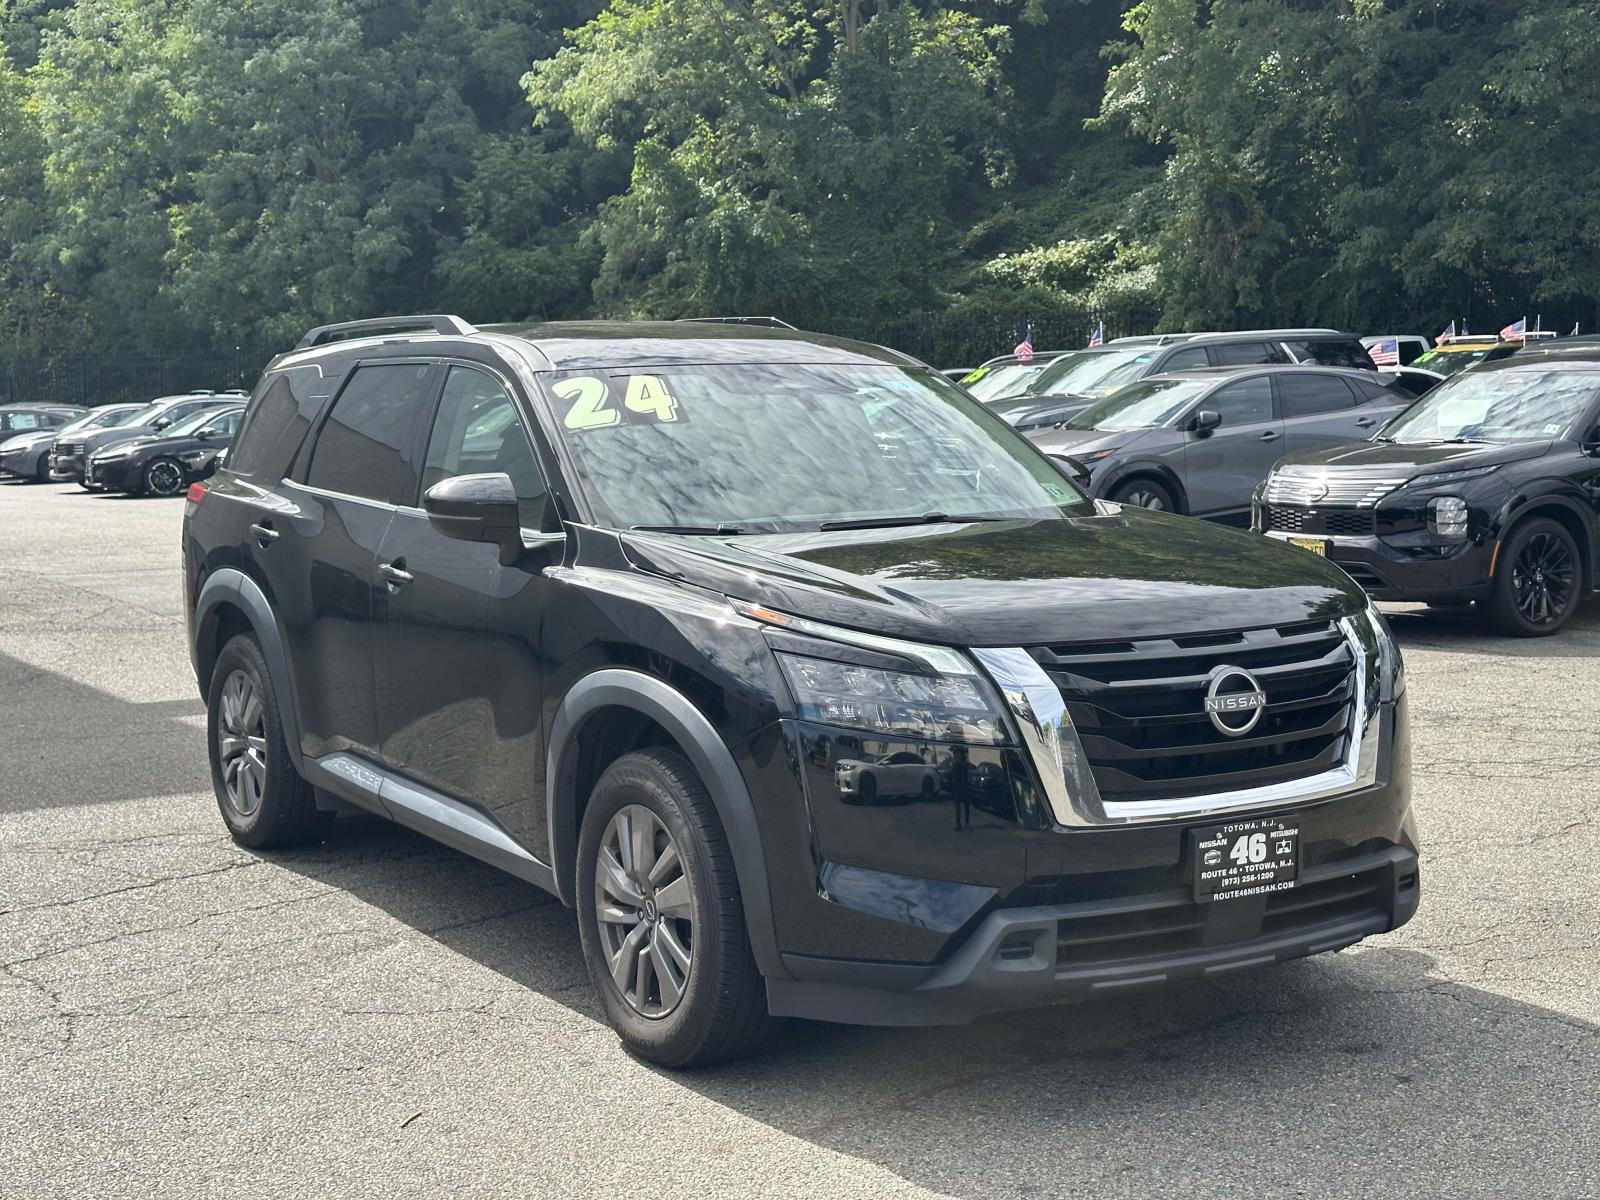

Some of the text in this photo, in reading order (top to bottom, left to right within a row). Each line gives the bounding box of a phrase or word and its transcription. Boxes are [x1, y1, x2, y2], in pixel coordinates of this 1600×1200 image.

[552, 375, 678, 429] 24
[1207, 694, 1265, 710] NISSAN
[1261, 819, 1277, 828] N.J.
[1199, 838, 1228, 849] NISSAN
[1229, 832, 1267, 865] 46
[1201, 858, 1295, 880] ROUTE 46 TOTOWA, N.J.
[1221, 871, 1275, 887] (973) 256-1200
[1213, 881, 1295, 901] ROUTE46NISSAN.COM
